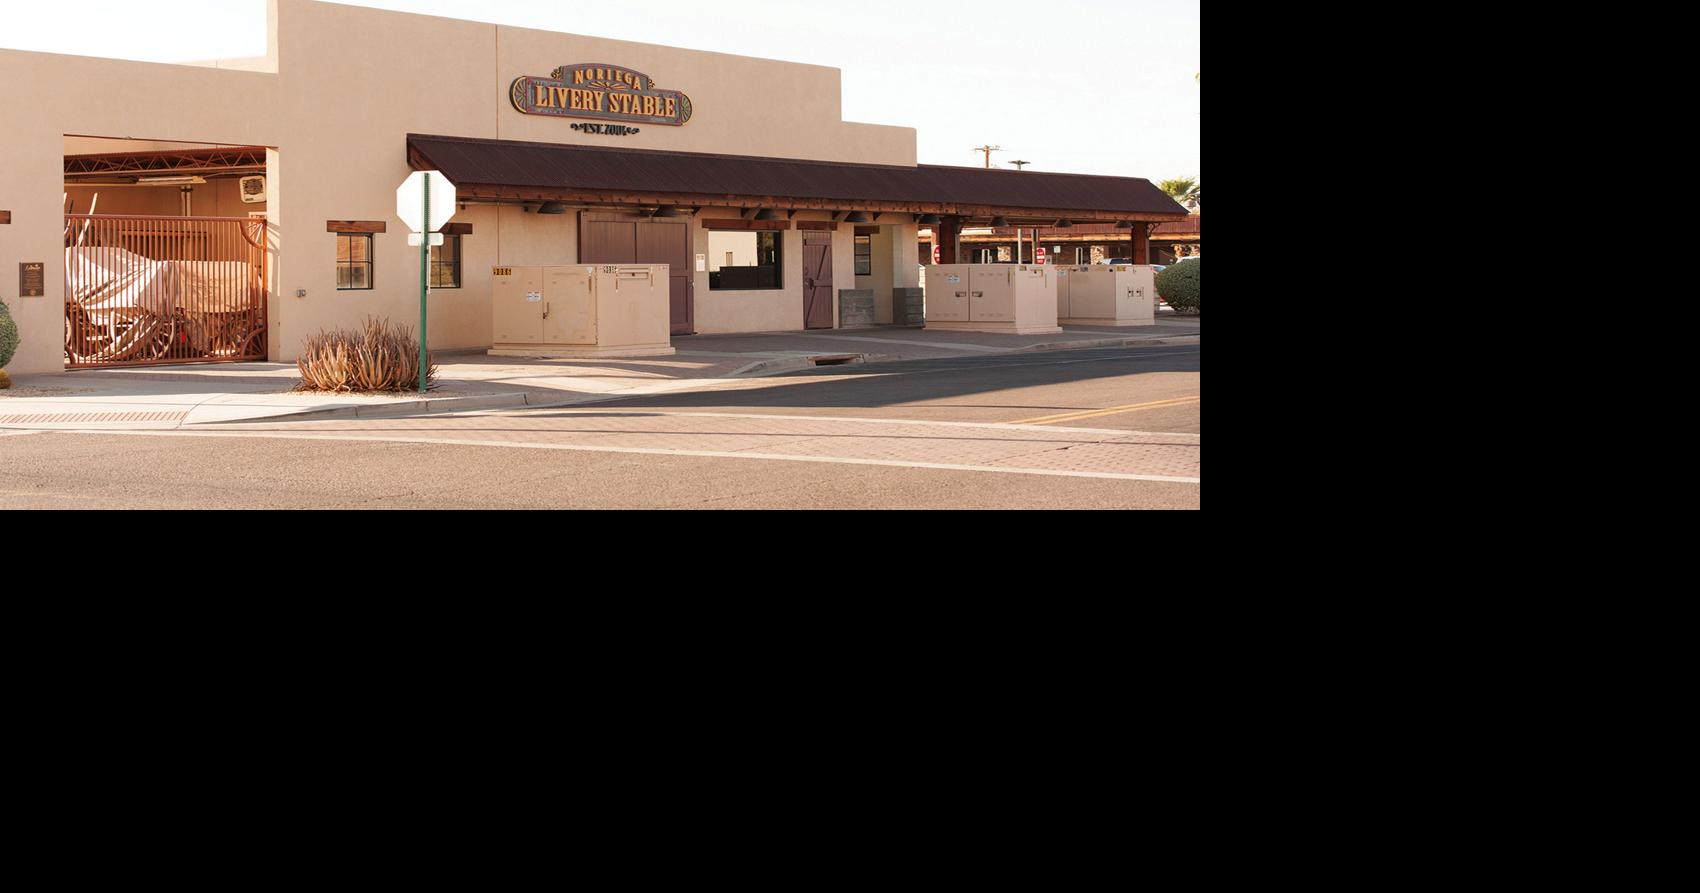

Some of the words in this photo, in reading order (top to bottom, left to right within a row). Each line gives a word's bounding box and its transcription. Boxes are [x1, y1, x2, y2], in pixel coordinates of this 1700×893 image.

[574, 68, 642, 91] NORIEGA
[534, 85, 605, 112] LIVERY
[608, 92, 676, 118] STABLE
